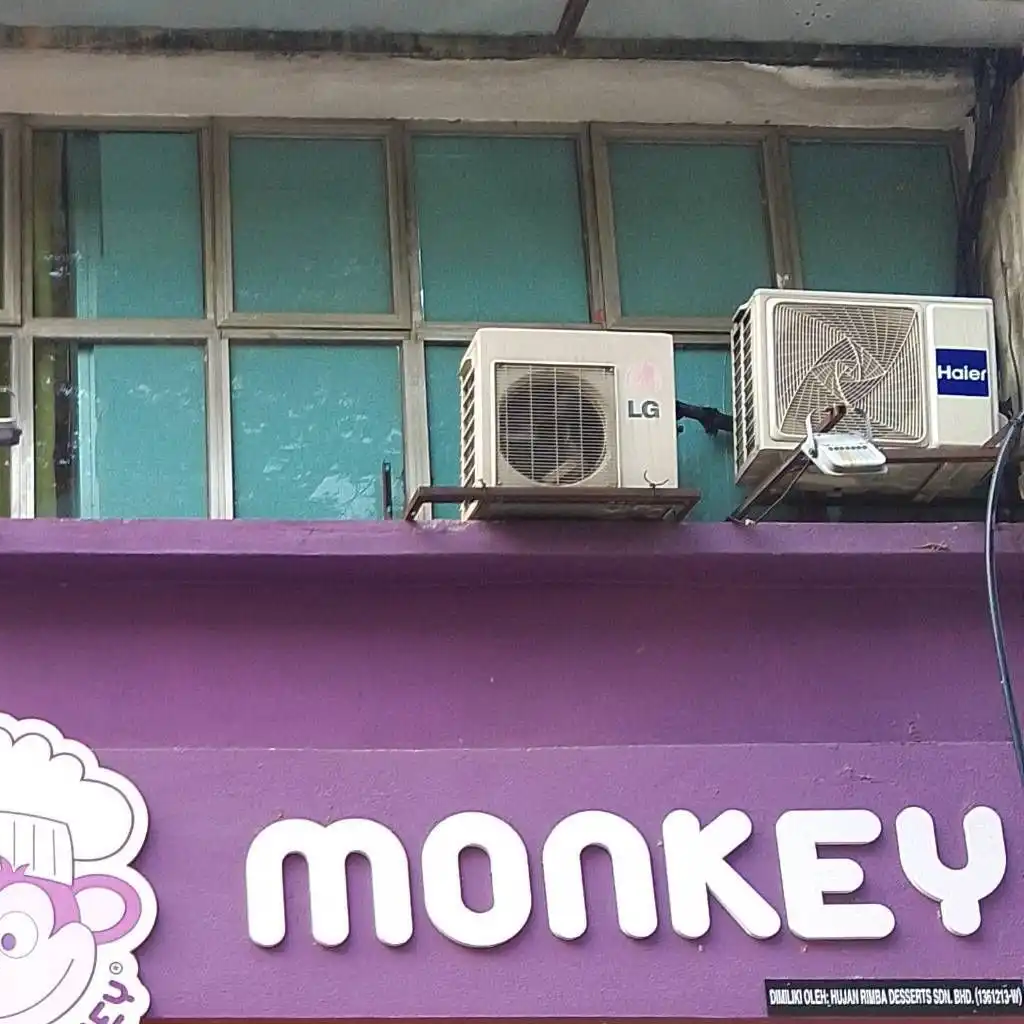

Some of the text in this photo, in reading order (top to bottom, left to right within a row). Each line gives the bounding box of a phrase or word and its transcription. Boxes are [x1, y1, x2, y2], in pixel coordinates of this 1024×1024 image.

[937, 364, 986, 382] Haier
[628, 400, 660, 418] LG
[245, 804, 1008, 949] MONKEY
[769, 989, 802, 1006] DIMILIKI
[804, 989, 829, 1006] OLEH:
[830, 989, 858, 1005] HUJAN
[860, 989, 887, 1005] RIMBA
[888, 989, 931, 1005] DESSERTS
[933, 989, 952, 1005] SDN.
[953, 988, 974, 1005] BHD.
